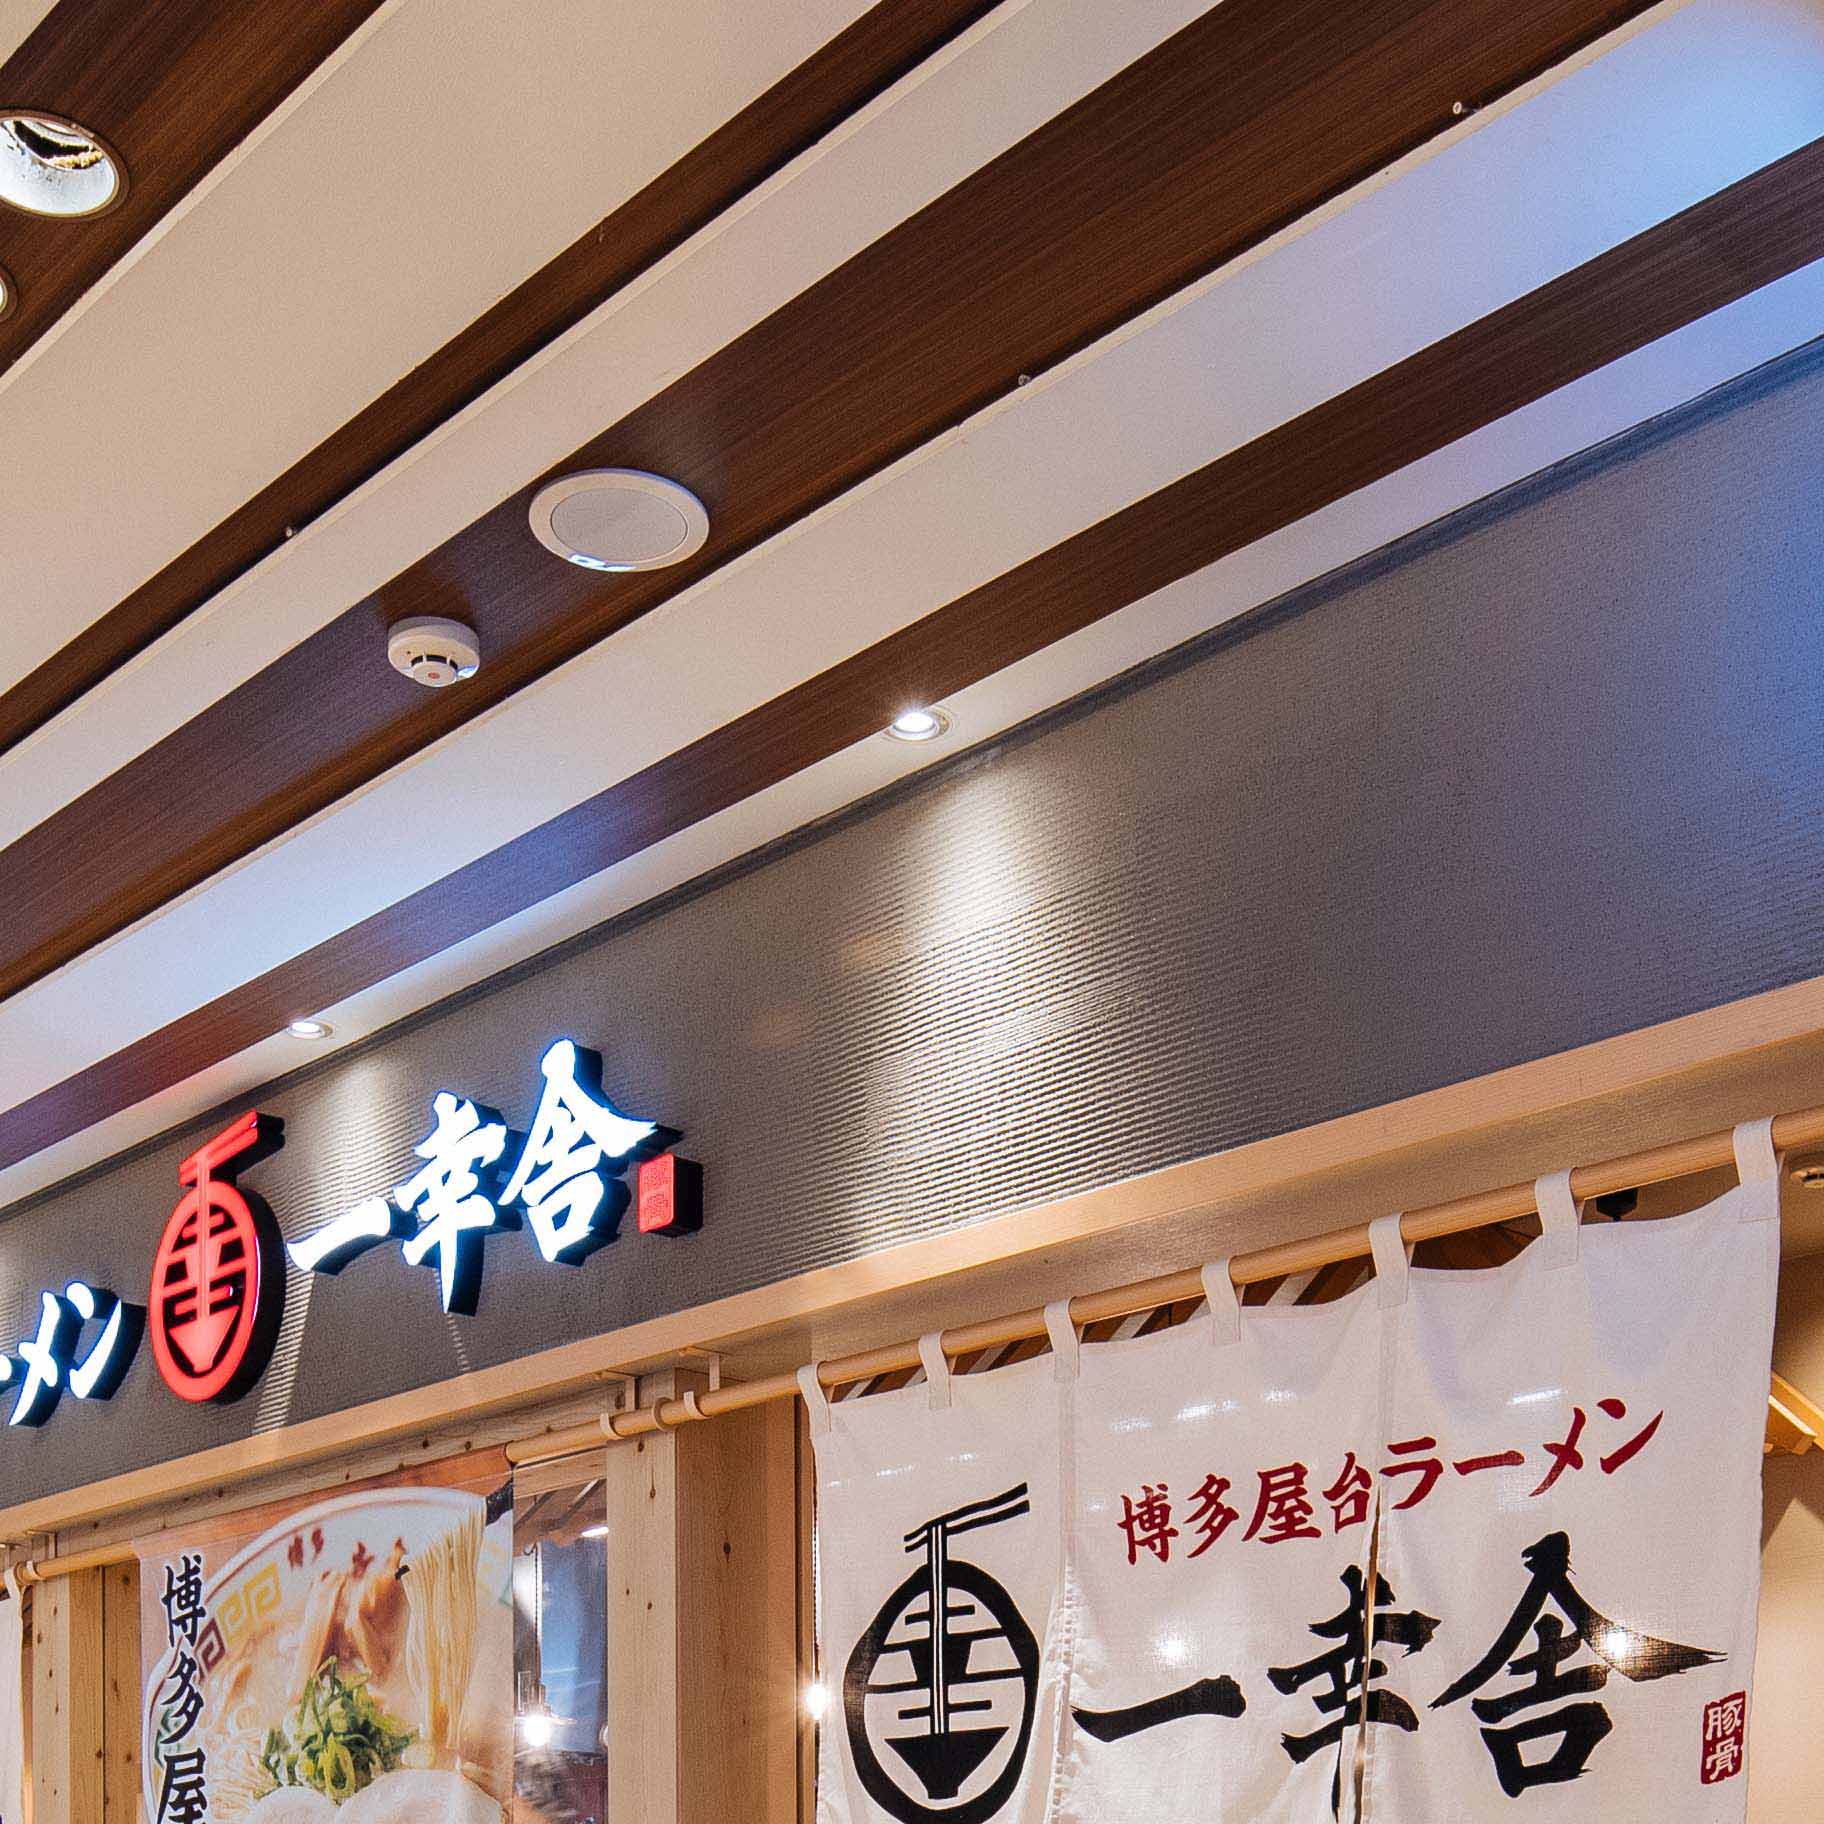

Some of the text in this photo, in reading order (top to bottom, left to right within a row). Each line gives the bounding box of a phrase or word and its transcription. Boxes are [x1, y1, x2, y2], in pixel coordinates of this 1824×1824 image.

[287, 1038, 657, 1313] 一幸舎
[1118, 1398, 1665, 1566] 博多屋台ラーメン
[1071, 1531, 1727, 1823] 一幸舎
[1706, 1702, 1743, 1782] 豚骨
